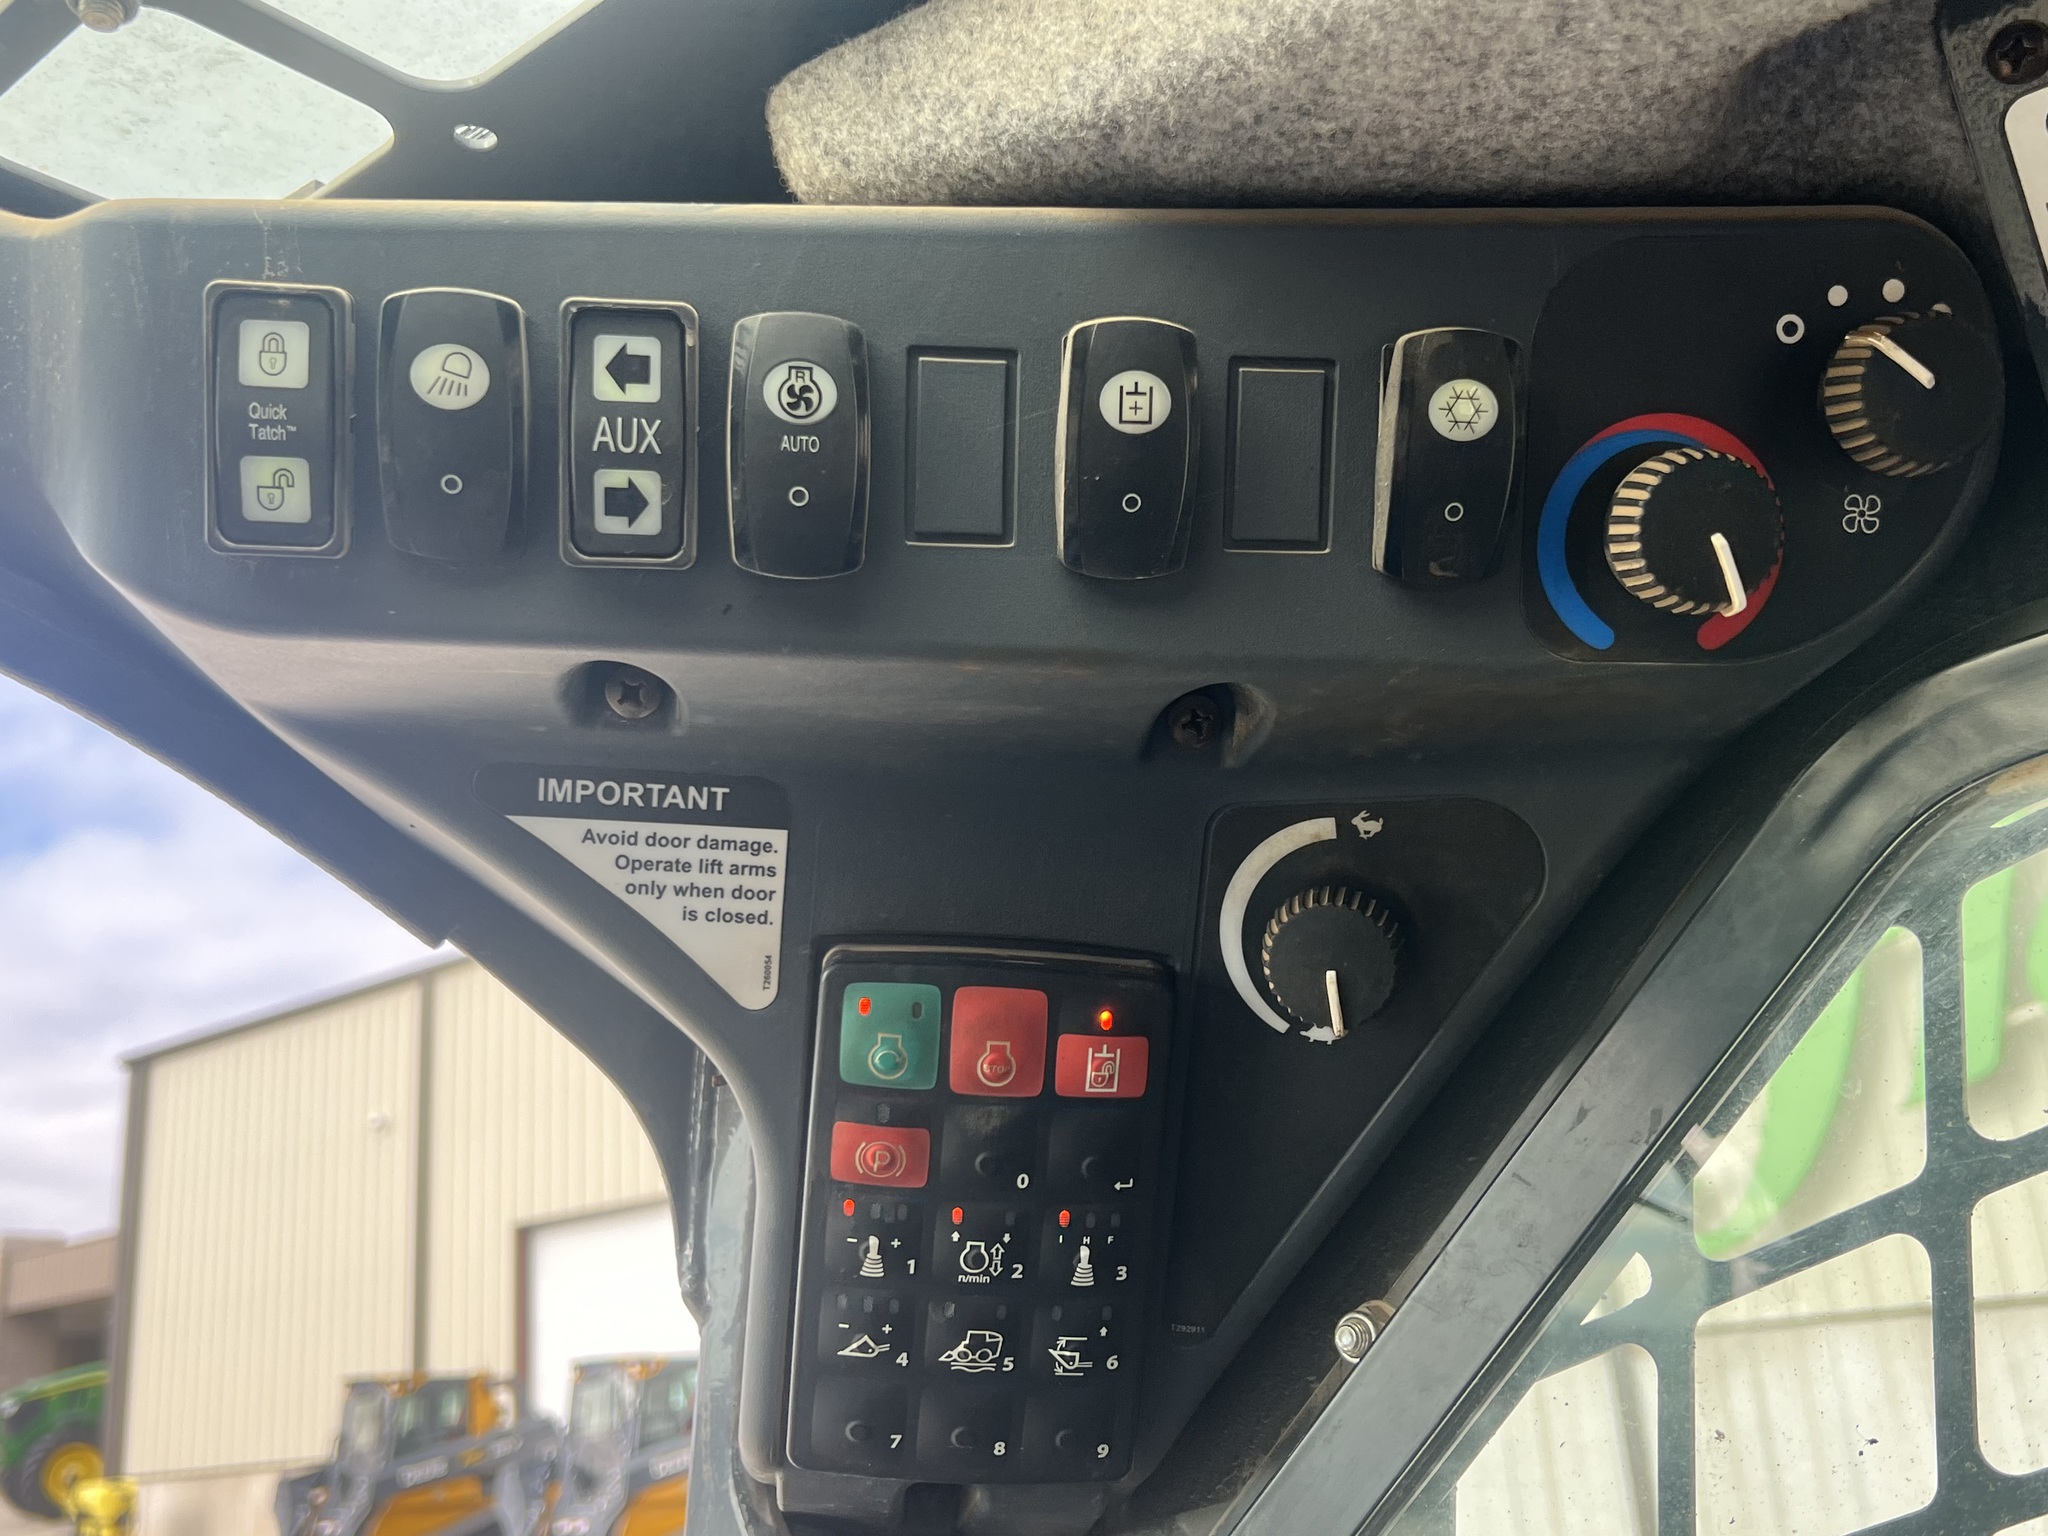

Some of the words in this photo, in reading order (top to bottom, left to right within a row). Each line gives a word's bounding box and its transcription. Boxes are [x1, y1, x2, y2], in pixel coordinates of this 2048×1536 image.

[796, 370, 806, 384] R
[248, 401, 288, 420] Quick
[592, 416, 662, 455] AUX
[780, 435, 820, 454] AUTO
[537, 777, 730, 811] IMPORTANT
[581, 828, 639, 847] Avoid
[645, 831, 691, 850] door
[696, 835, 779, 857] damage.
[614, 854, 692, 874] Operate
[699, 858, 724, 875] lift
[729, 863, 777, 877] arms
[624, 880, 667, 899] only
[673, 883, 725, 899] when
[731, 884, 777, 901] door
[682, 906, 699, 922] is
[705, 908, 774, 926] closed.
[983, 1064, 1011, 1073] STOP
[873, 1150, 890, 1172] P
[1016, 1173, 1030, 1190] 0
[1082, 1236, 1091, 1245] H
[1107, 1235, 1115, 1245] F
[906, 1258, 917, 1275] 1
[1010, 1263, 1024, 1279] 2
[1115, 1265, 1128, 1281] 3
[957, 1274, 991, 1284] n/min
[895, 1352, 910, 1367] 4
[1002, 1357, 1015, 1372] 5
[1105, 1355, 1119, 1370] 6
[890, 1434, 903, 1449] 7
[993, 1441, 1007, 1456] 8
[1096, 1444, 1110, 1459] 9
